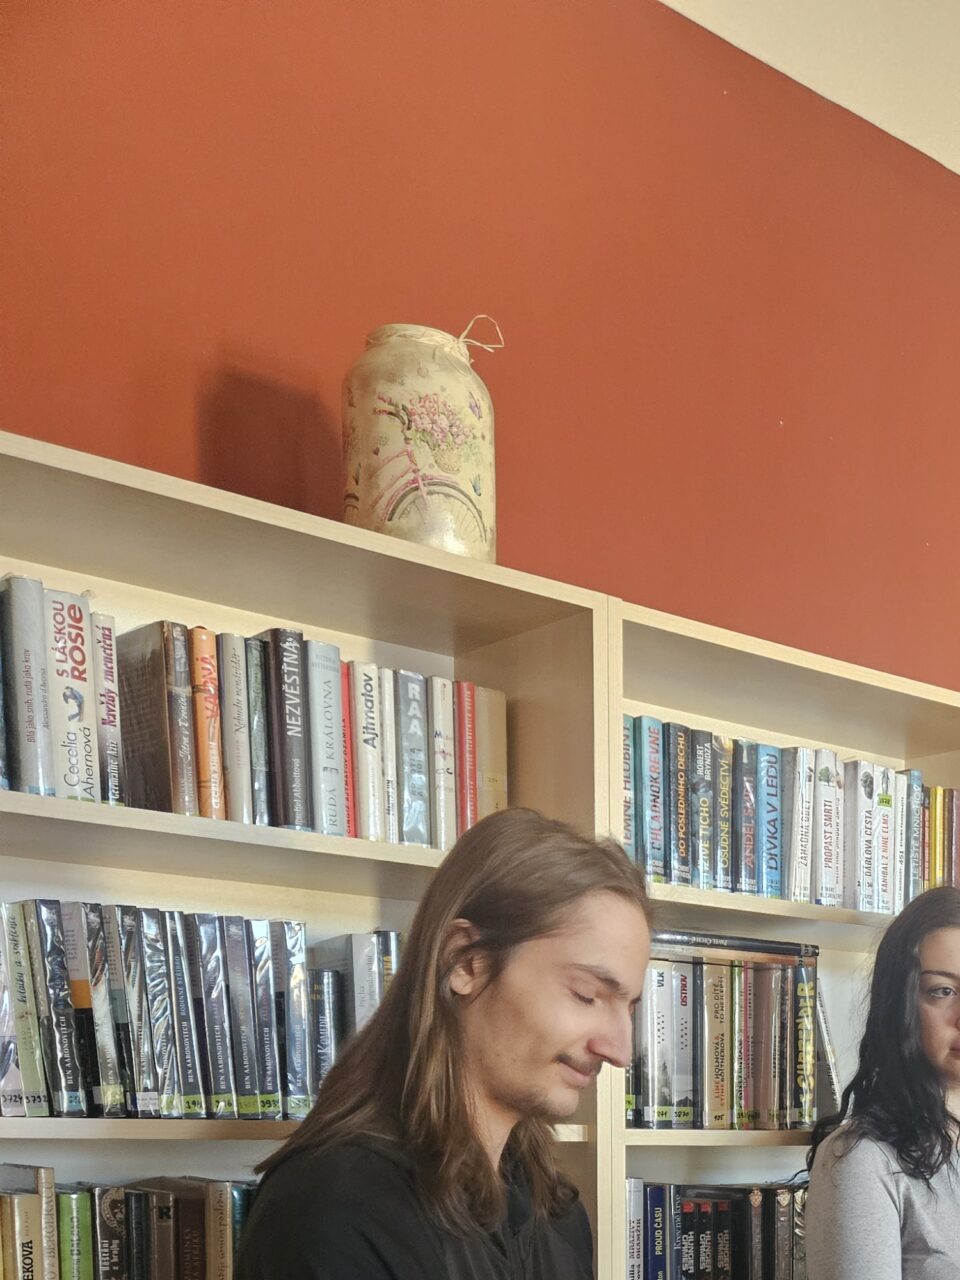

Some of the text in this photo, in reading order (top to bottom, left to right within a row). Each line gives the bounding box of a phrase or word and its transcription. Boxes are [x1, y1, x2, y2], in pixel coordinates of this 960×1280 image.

[51, 600, 69, 677] S LÁSKOU
[100, 689, 122, 727] Navždy
[280, 642, 302, 737] NEZVĚSTNÁ
[232, 699, 246, 734] Nebudu
[321, 680, 337, 760] KRÁLOVNA
[360, 672, 379, 749] Ajtmatov
[60, 732, 80, 787] Cecelia
[79, 727, 95, 798] Ahernová
[677, 732, 685, 770] DECHU
[696, 744, 704, 775] ROBERT
[704, 743, 712, 780] BRYNDZA
[766, 753, 778, 813] V LEDU
[325, 788, 338, 827] RUDÁ
[699, 798, 709, 836] TICHO
[823, 800, 833, 828] SMRTI
[864, 809, 872, 836] CESTA
[911, 784, 920, 837] MNICHOV
[678, 840, 686, 857] DO
[718, 821, 729, 868] OSUDNÉ
[823, 830, 833, 869] PROPAST
[653, 1207, 663, 1255] PROUD ČASU
